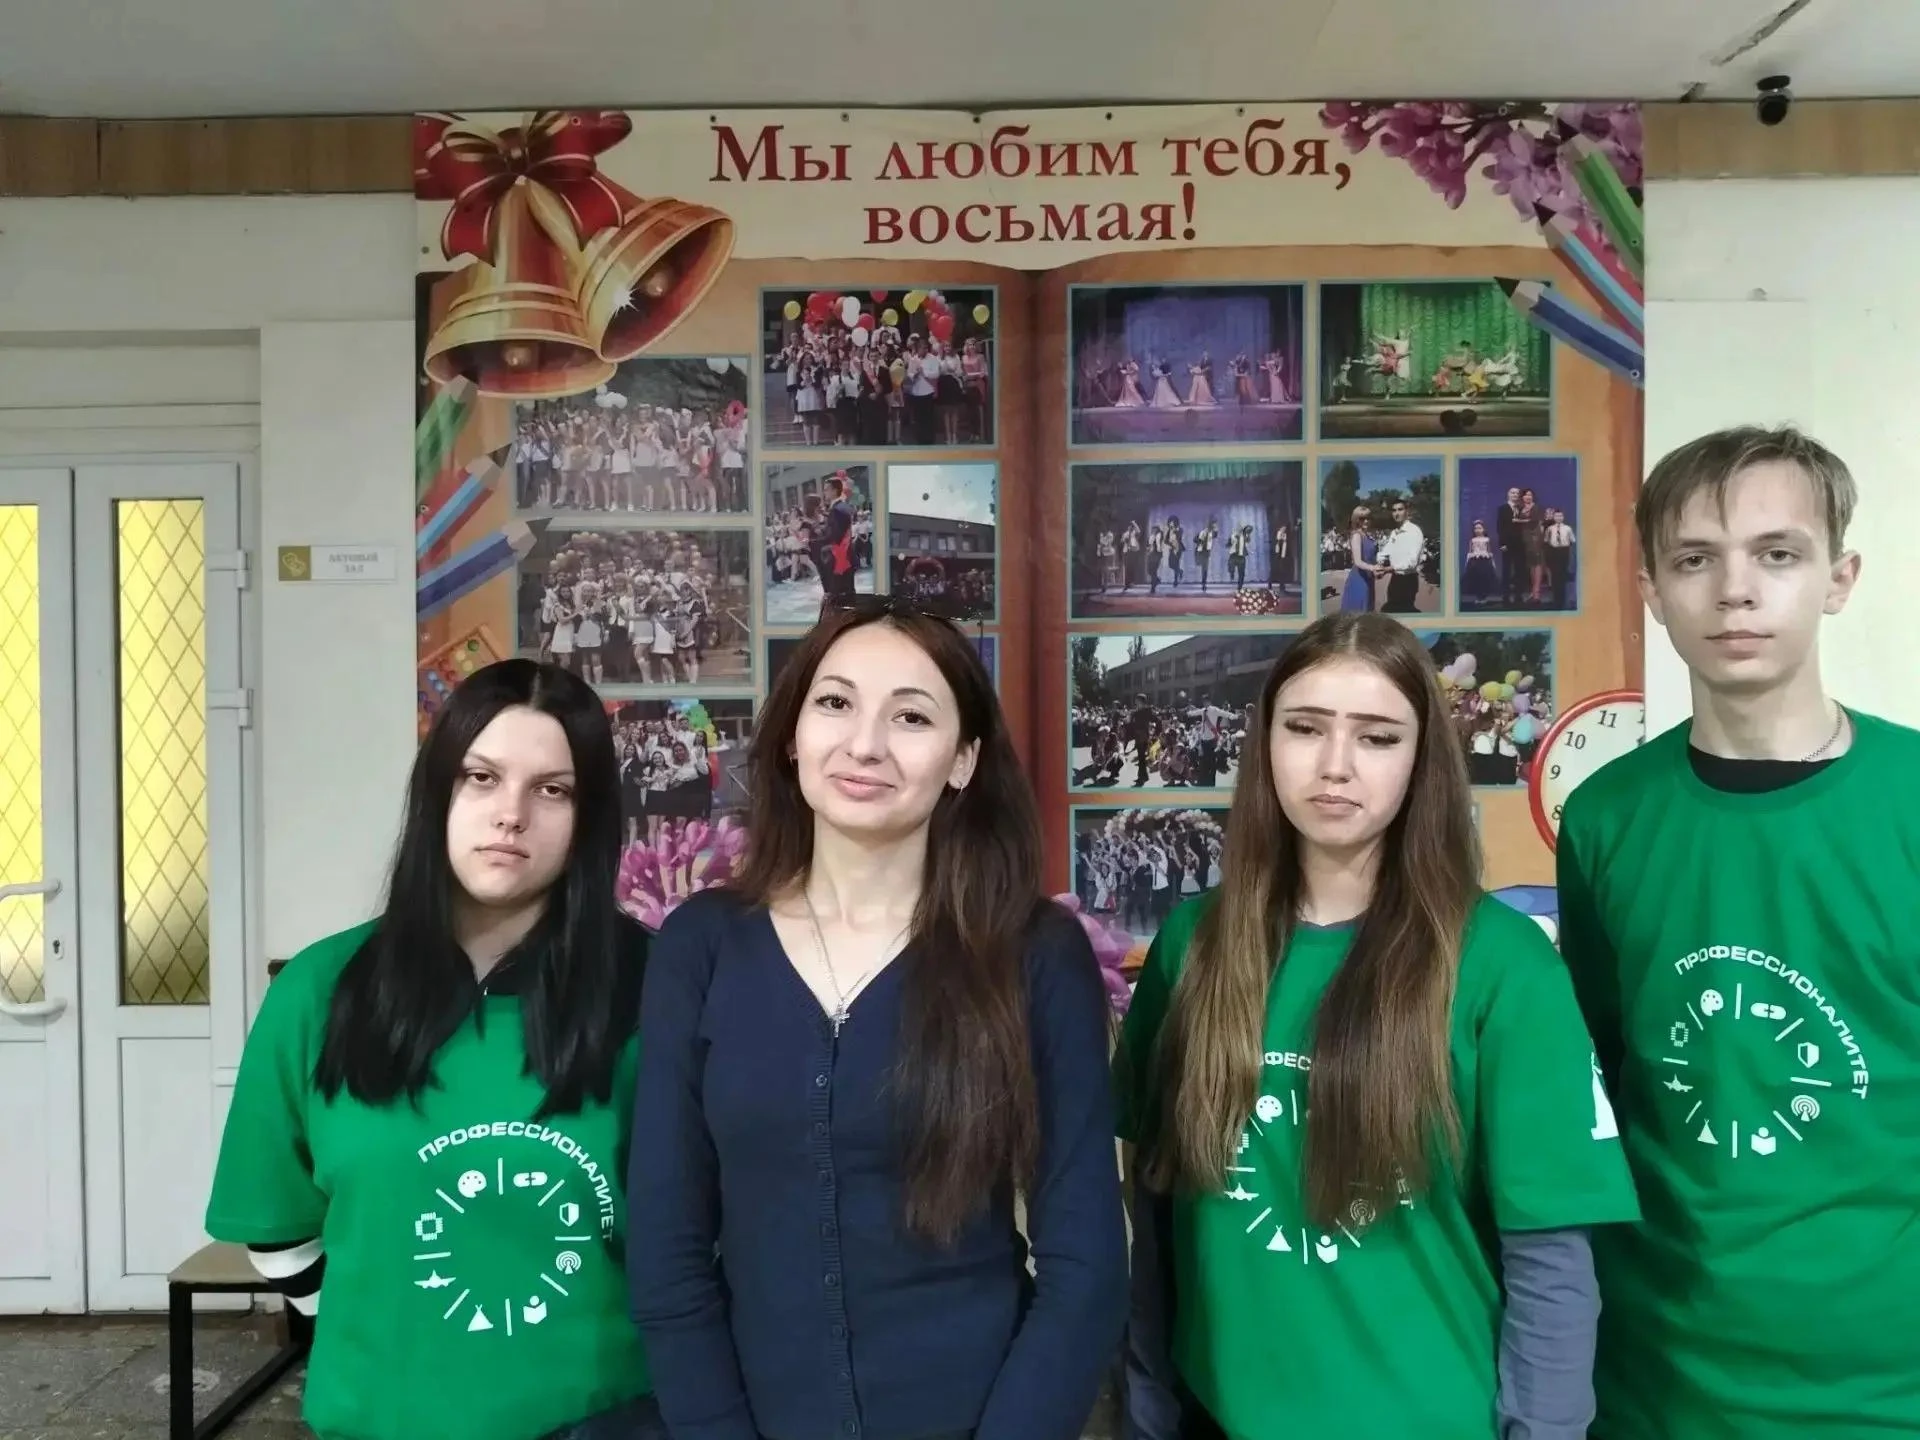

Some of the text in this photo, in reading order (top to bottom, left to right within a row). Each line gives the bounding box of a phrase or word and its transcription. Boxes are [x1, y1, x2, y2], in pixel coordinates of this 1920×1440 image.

[709, 119, 1352, 191] Мы любим тебя,
[863, 182, 1198, 244] восьмая!
[1597, 710, 1618, 728] 11
[1564, 731, 1586, 750] 10
[1550, 764, 1561, 780] 9
[1551, 804, 1563, 820] 8
[1674, 945, 1869, 1100] ПРОФЕССИОНАЛИТЕТ
[417, 1121, 614, 1242] ПРОФЕССИОНАЛИТЕТ
